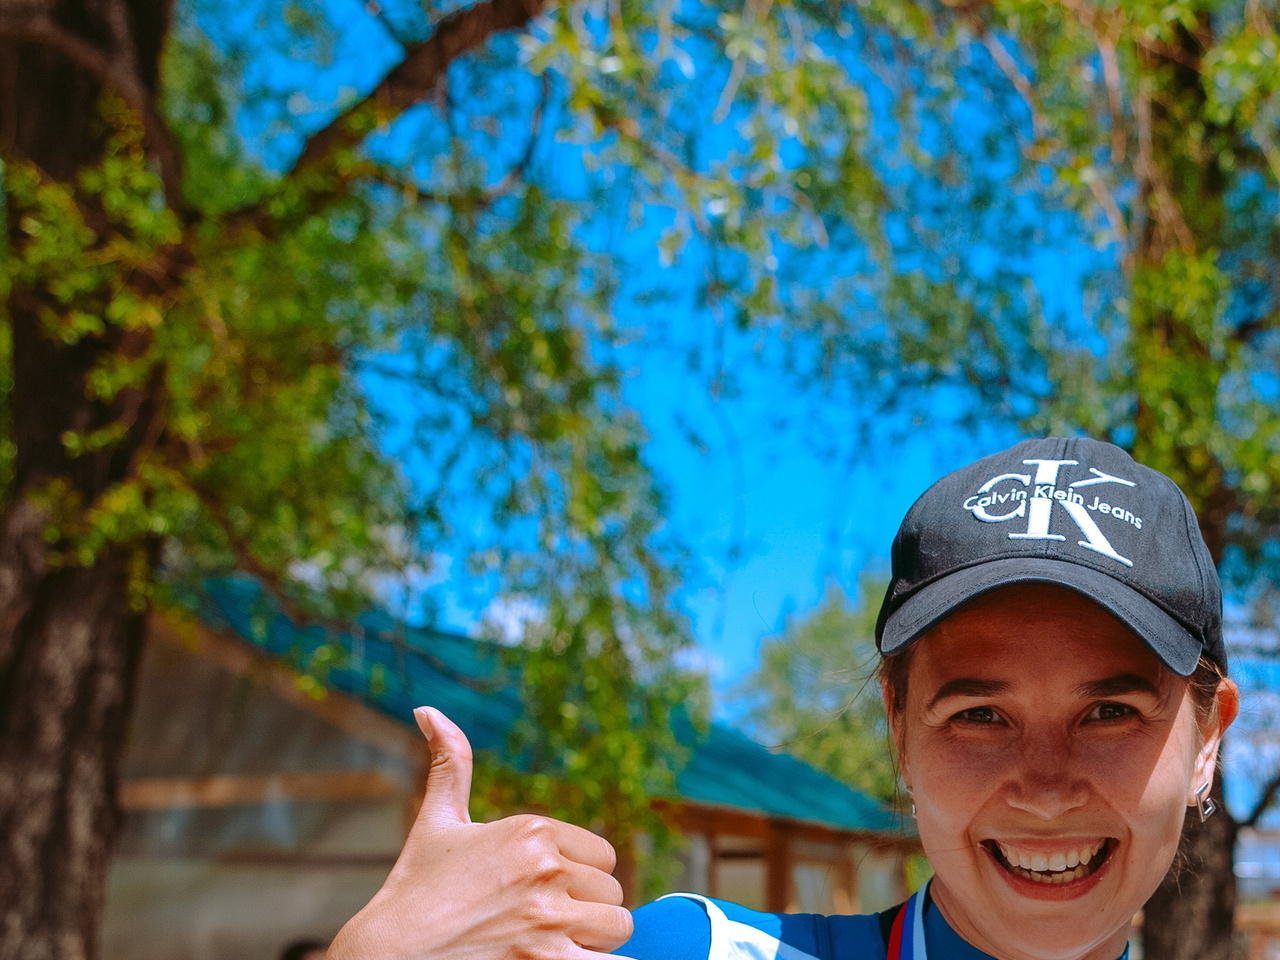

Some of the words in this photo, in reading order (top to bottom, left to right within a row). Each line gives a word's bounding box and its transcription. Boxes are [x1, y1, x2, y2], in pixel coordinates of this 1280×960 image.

[963, 487, 1028, 511] Calvin
[1033, 486, 1084, 507] Klein
[1087, 496, 1143, 530] Jeans
